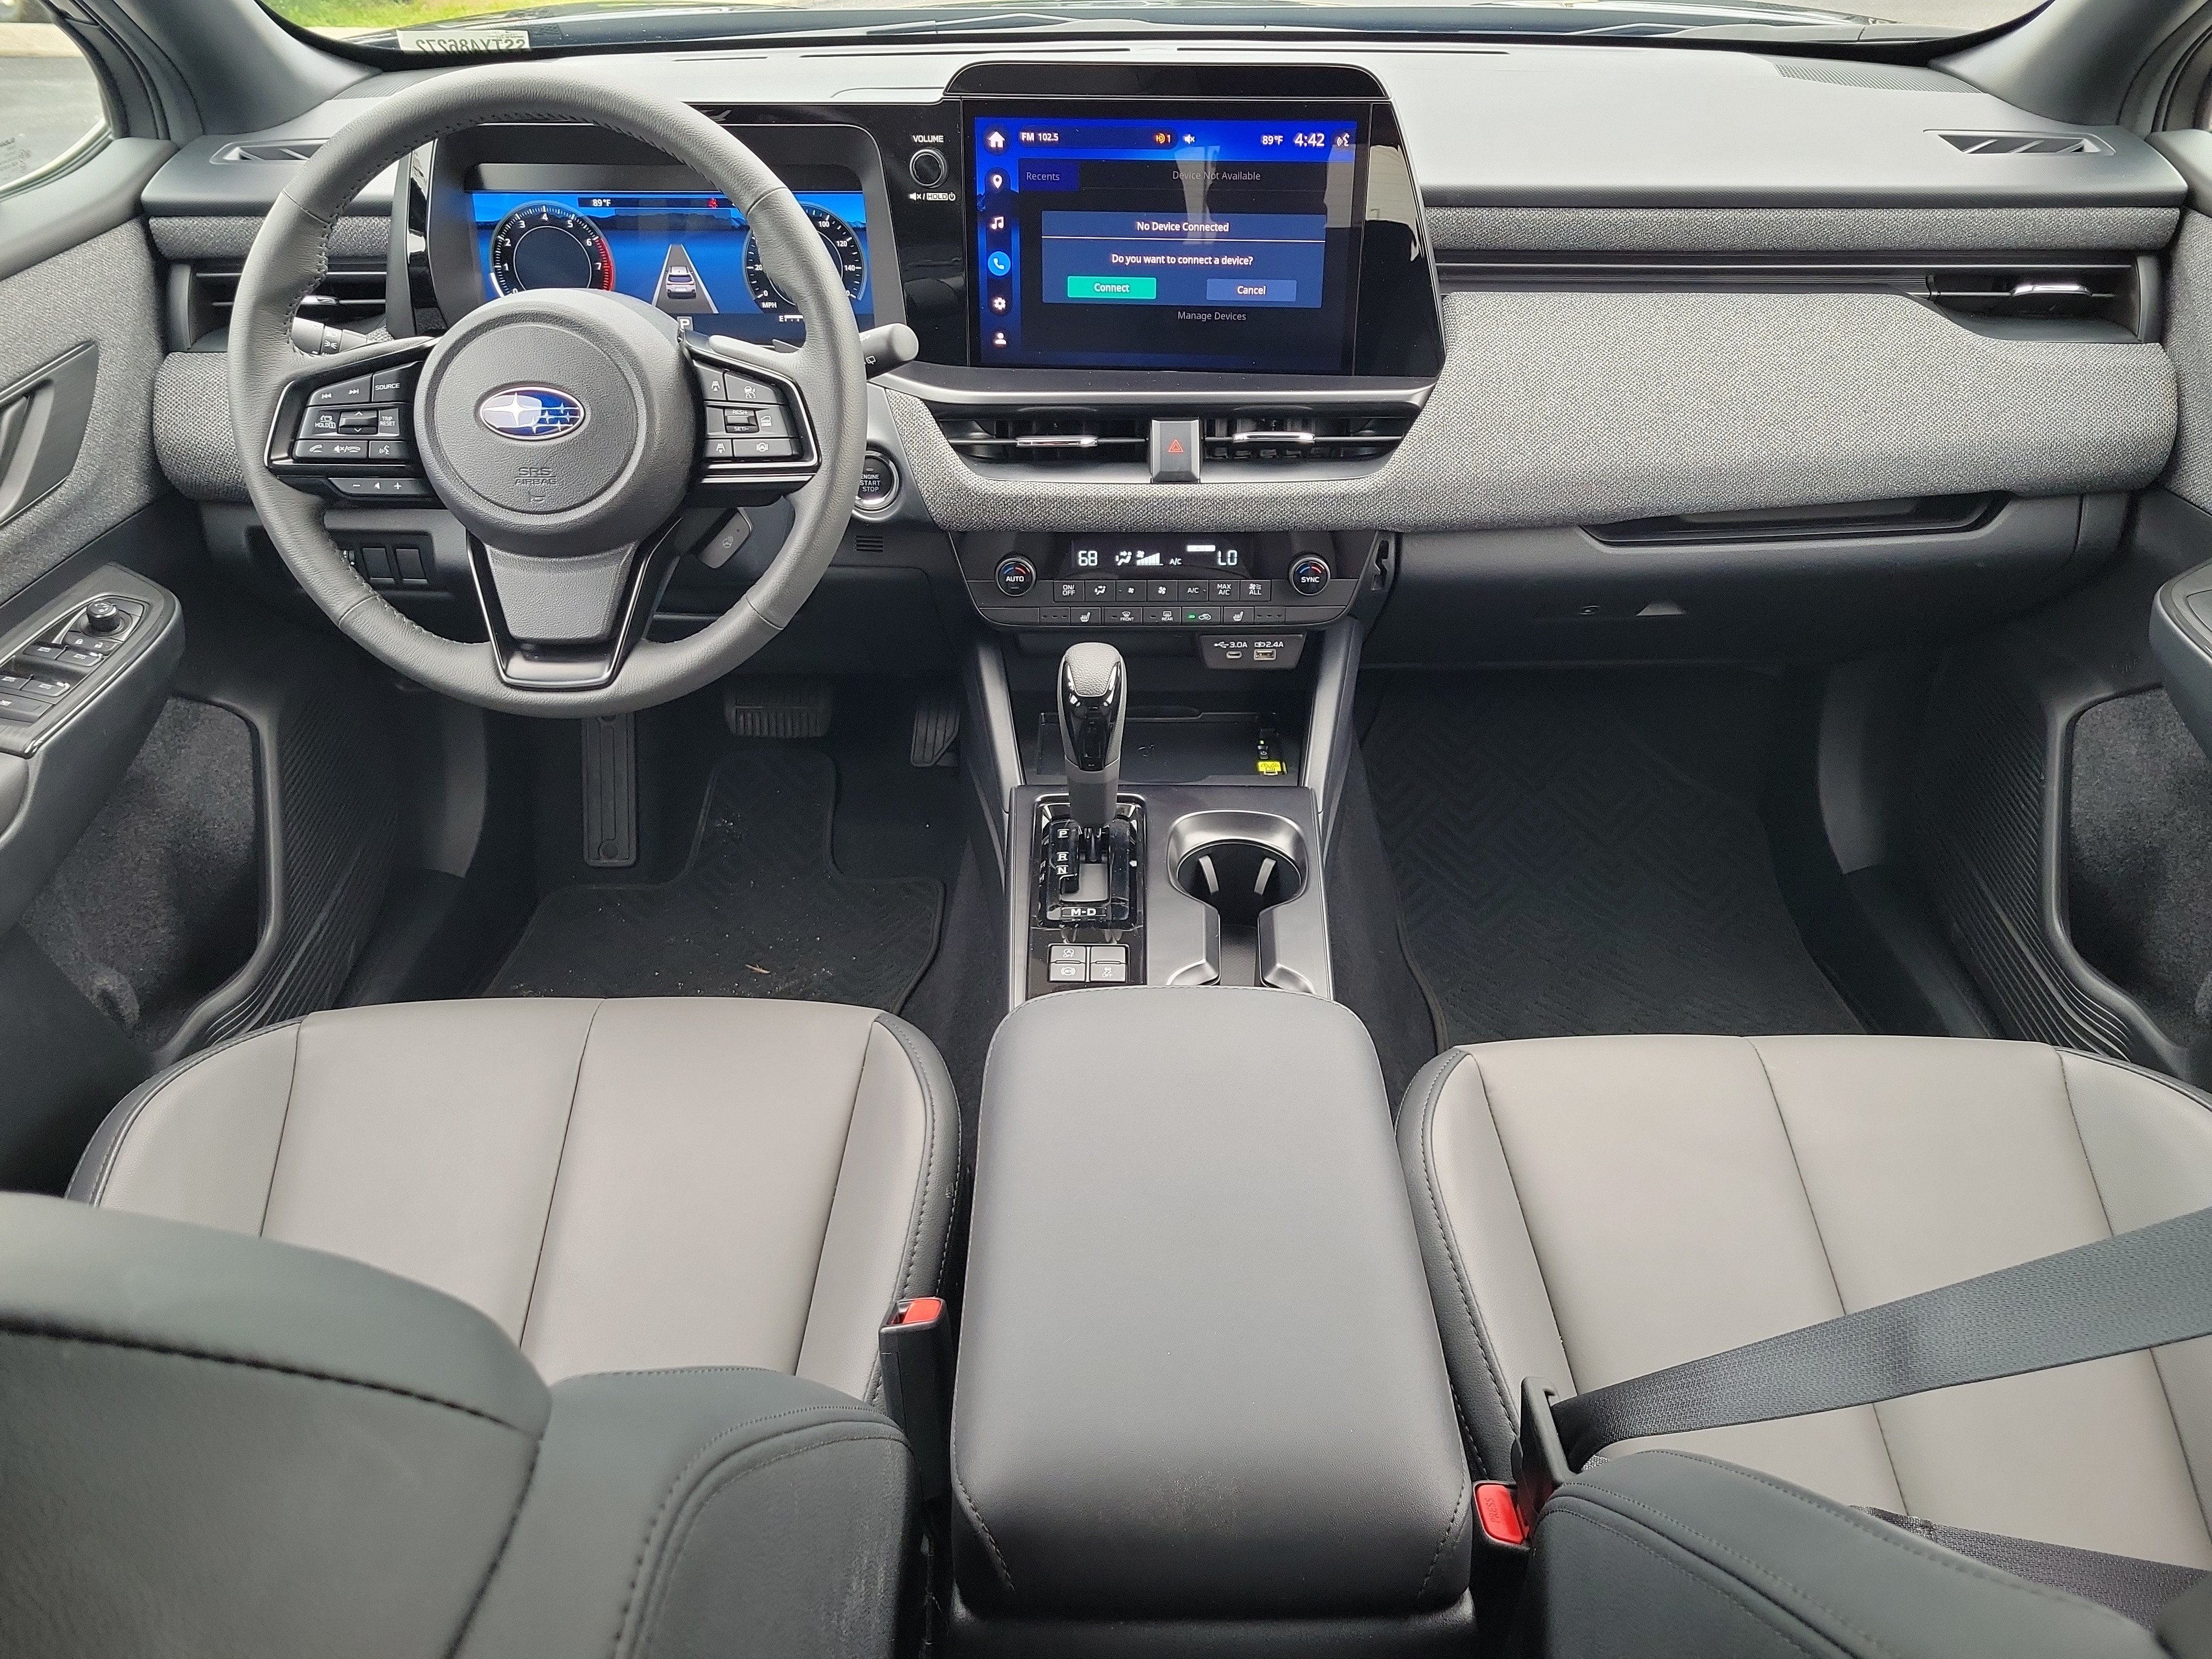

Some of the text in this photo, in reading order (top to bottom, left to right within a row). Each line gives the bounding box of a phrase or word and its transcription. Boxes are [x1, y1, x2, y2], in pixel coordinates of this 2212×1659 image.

[1022, 133, 1059, 142] FM 102.5
[1262, 136, 1283, 145] 89°F
[1294, 133, 1325, 146] 4:42
[1026, 172, 1060, 181] Recents
[1172, 171, 1261, 180] Device Not Available
[1137, 222, 1229, 232] No Device Connected
[1111, 254, 1124, 263] Do
[1126, 256, 1142, 266] you
[1143, 256, 1165, 264] want
[1166, 256, 1176, 264] to
[1178, 256, 1212, 265] connect
[1221, 256, 1253, 266] device?
[1094, 283, 1130, 292] Connect
[1237, 285, 1266, 295] Cancel
[1178, 311, 1246, 321] Manage Devices
[680, 319, 690, 329] P
[1078, 550, 1098, 566] 68
[1217, 550, 1238, 566] LO
[1485, 1497, 1501, 1523] PRESS
